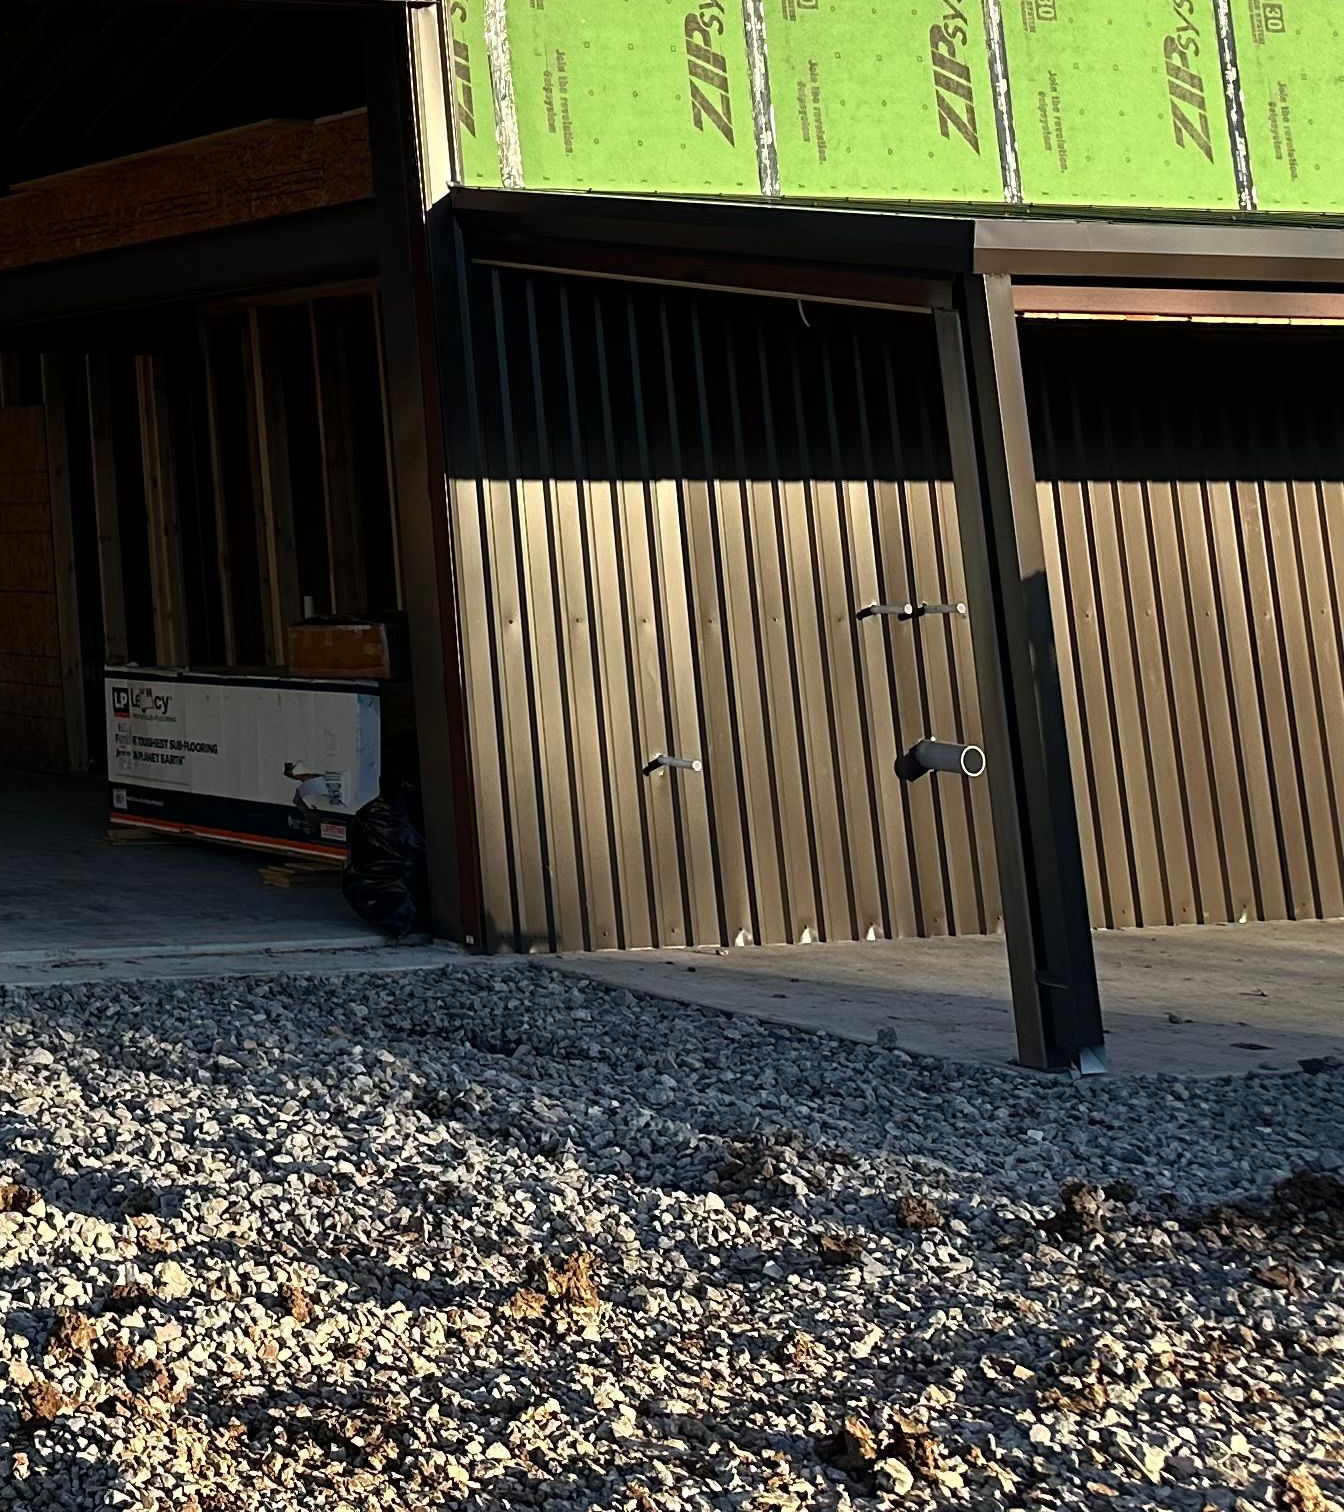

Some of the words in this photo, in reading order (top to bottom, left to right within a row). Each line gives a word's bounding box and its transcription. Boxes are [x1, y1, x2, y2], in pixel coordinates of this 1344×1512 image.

[1265, 7, 1283, 30] 30
[556, 48, 567, 72] Join
[808, 59, 819, 83] Join
[558, 76, 569, 94] the
[1047, 70, 1058, 92] Join
[1277, 80, 1288, 103] Join
[811, 86, 821, 104] the
[1051, 96, 1061, 113] the
[1281, 106, 1291, 123] the
[114, 691, 129, 708] LP
[130, 687, 170, 715] Lecy
